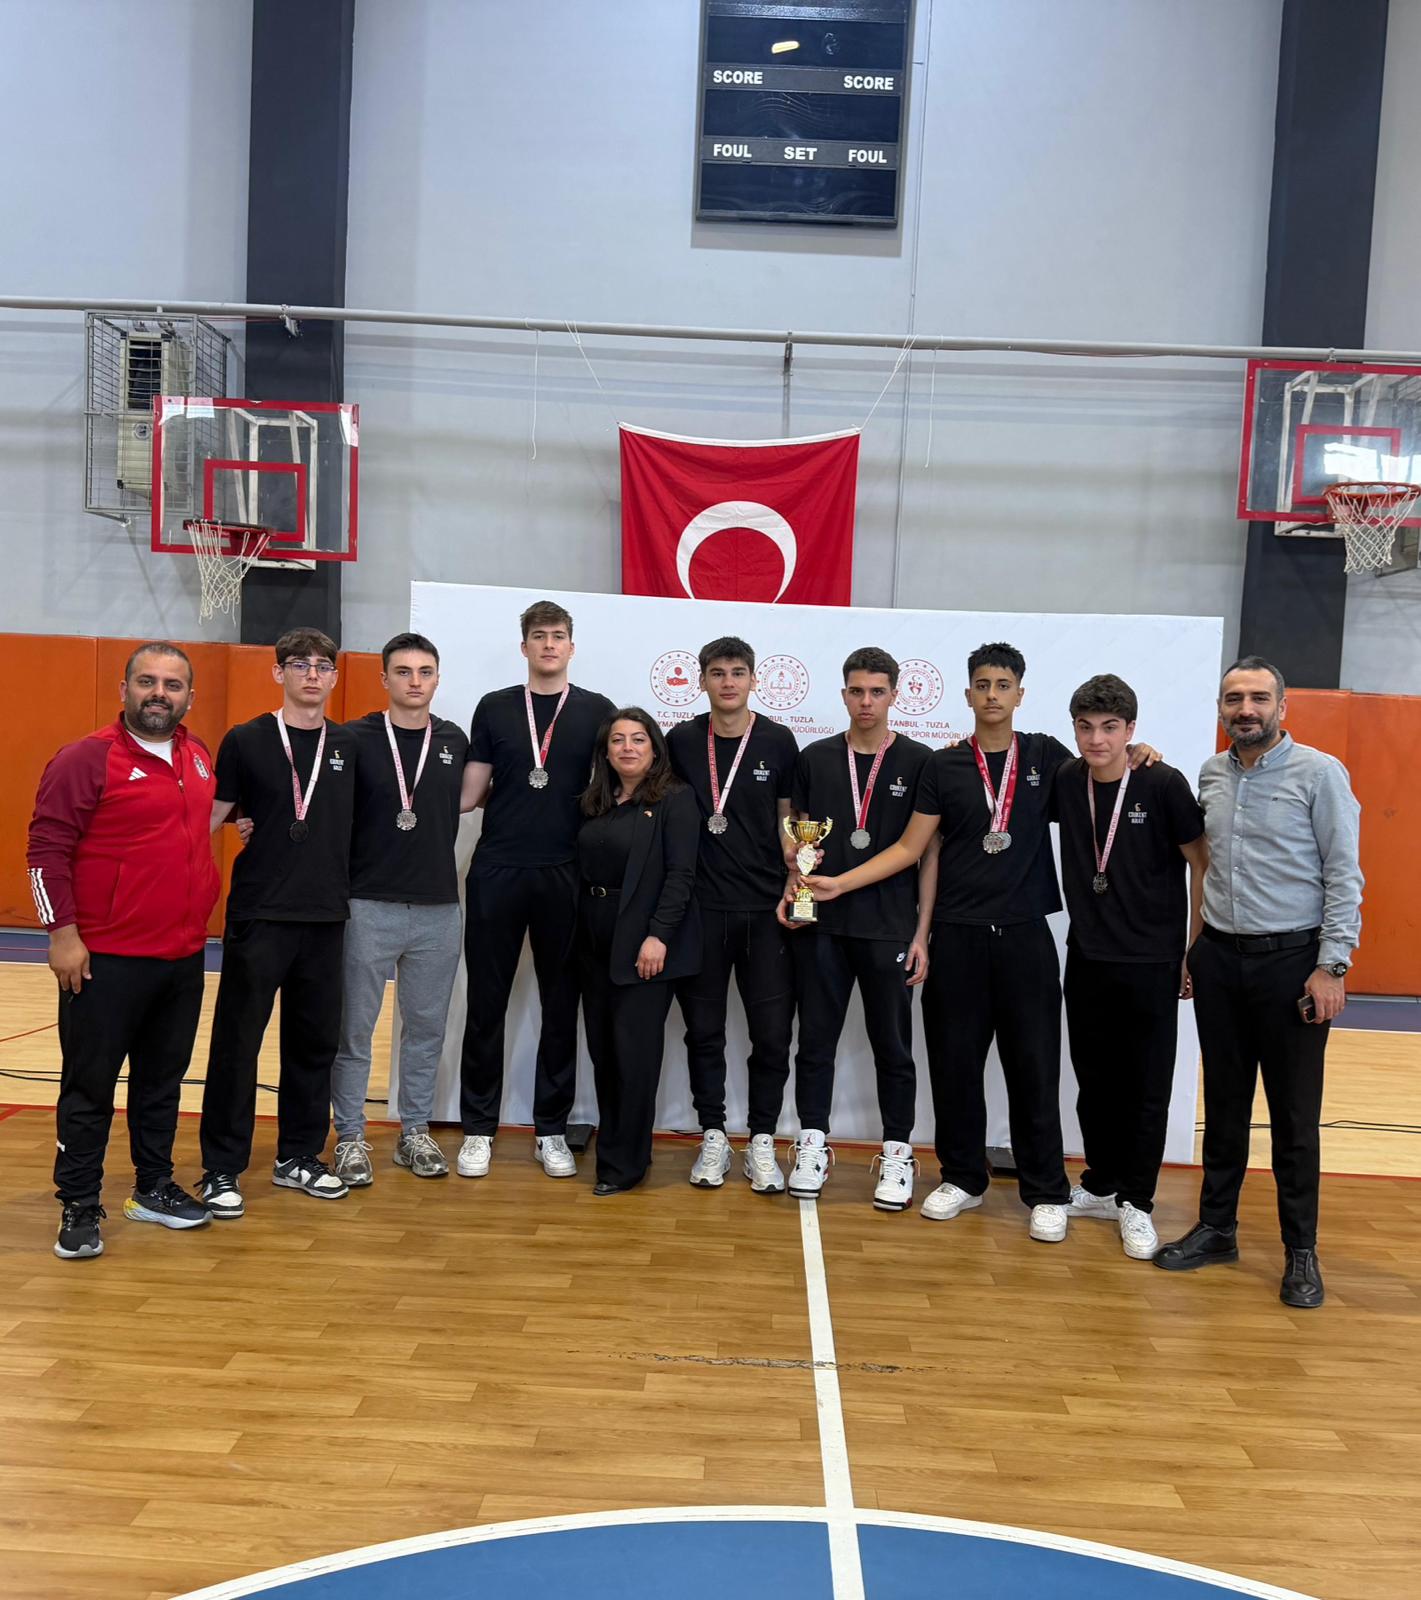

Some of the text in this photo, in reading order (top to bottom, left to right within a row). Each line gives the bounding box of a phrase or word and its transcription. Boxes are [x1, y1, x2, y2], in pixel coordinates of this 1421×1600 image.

[713, 70, 763, 85] SCORE
[843, 75, 894, 91] SCORE
[713, 144, 752, 158] FOUL
[784, 147, 817, 161] SET
[848, 150, 887, 164] FOUL
[789, 716, 814, 724] TUZLA
[925, 721, 950, 729] TUZLA
[911, 730, 930, 738] SPOR
